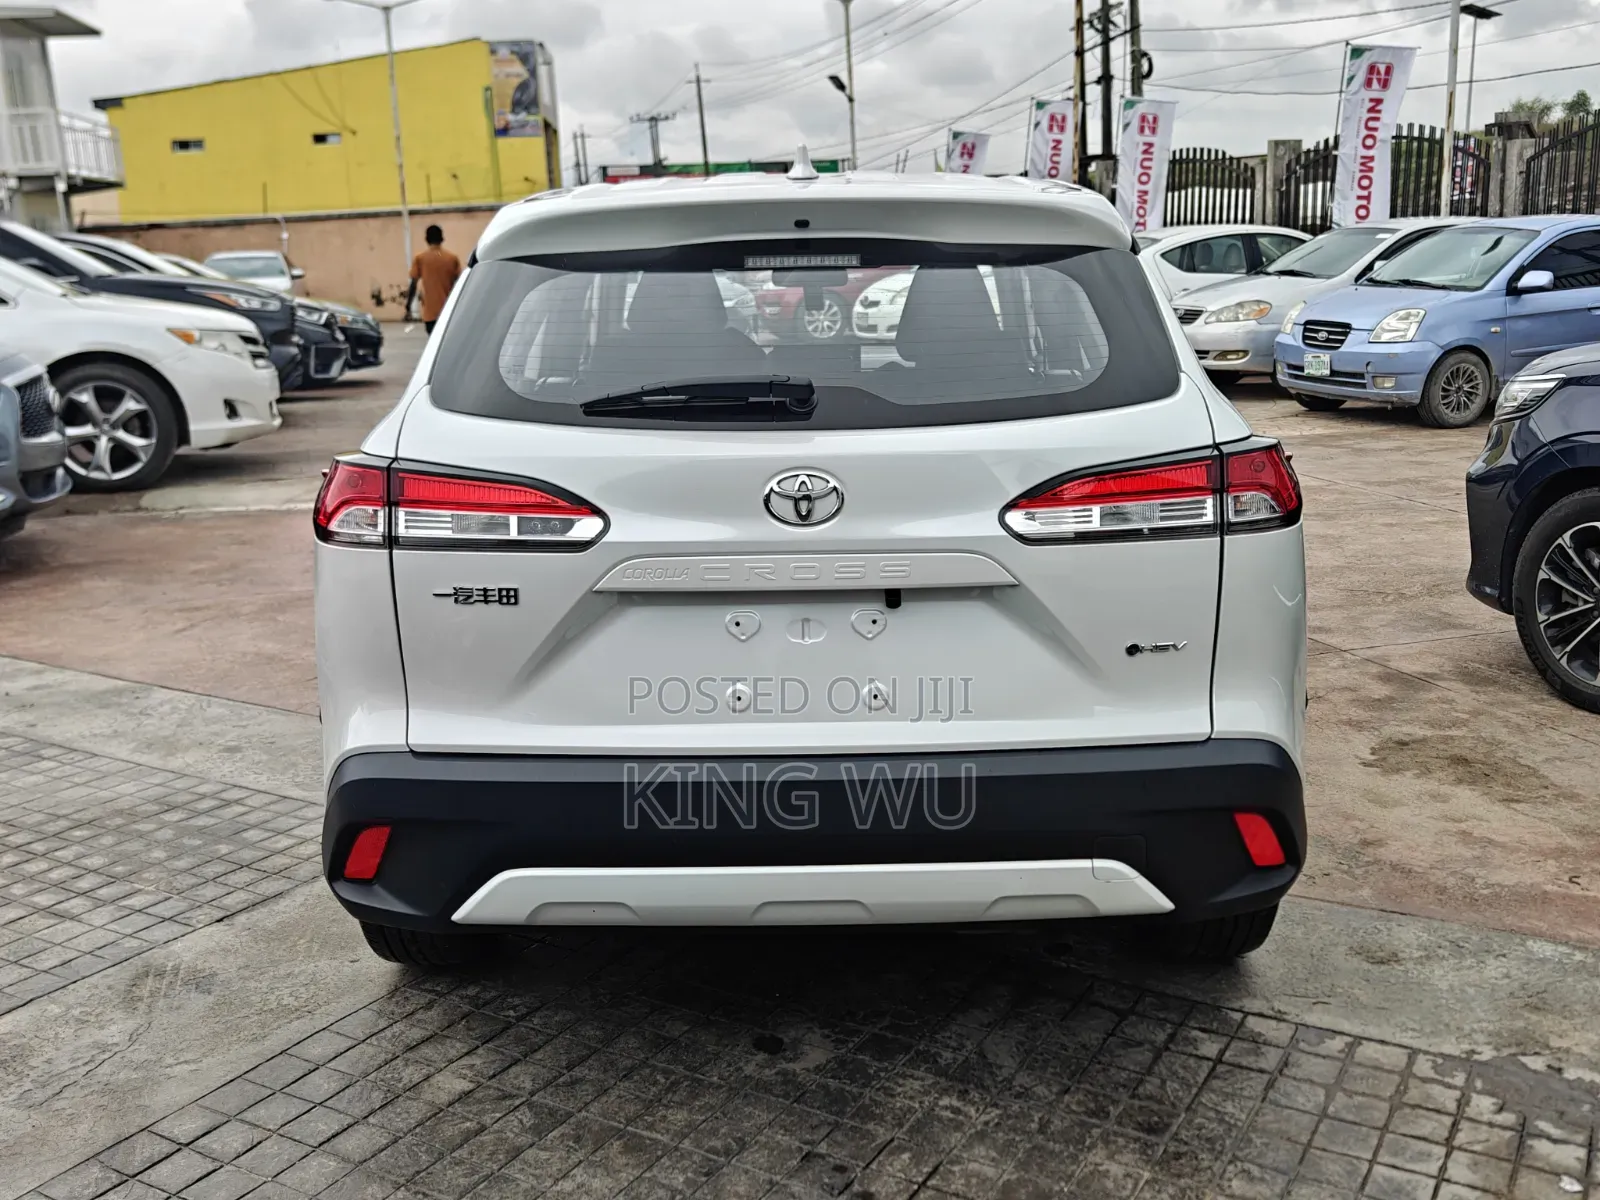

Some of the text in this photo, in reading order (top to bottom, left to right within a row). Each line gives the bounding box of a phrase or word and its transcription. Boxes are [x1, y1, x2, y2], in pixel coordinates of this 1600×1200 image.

[1362, 98, 1384, 151] NUO
[1048, 139, 1063, 178] NUO
[1137, 142, 1155, 185] NUO
[1354, 155, 1376, 224] MOTO
[622, 561, 912, 582] COROLLA CROSS
[432, 586, 519, 605] 一汽丰田
